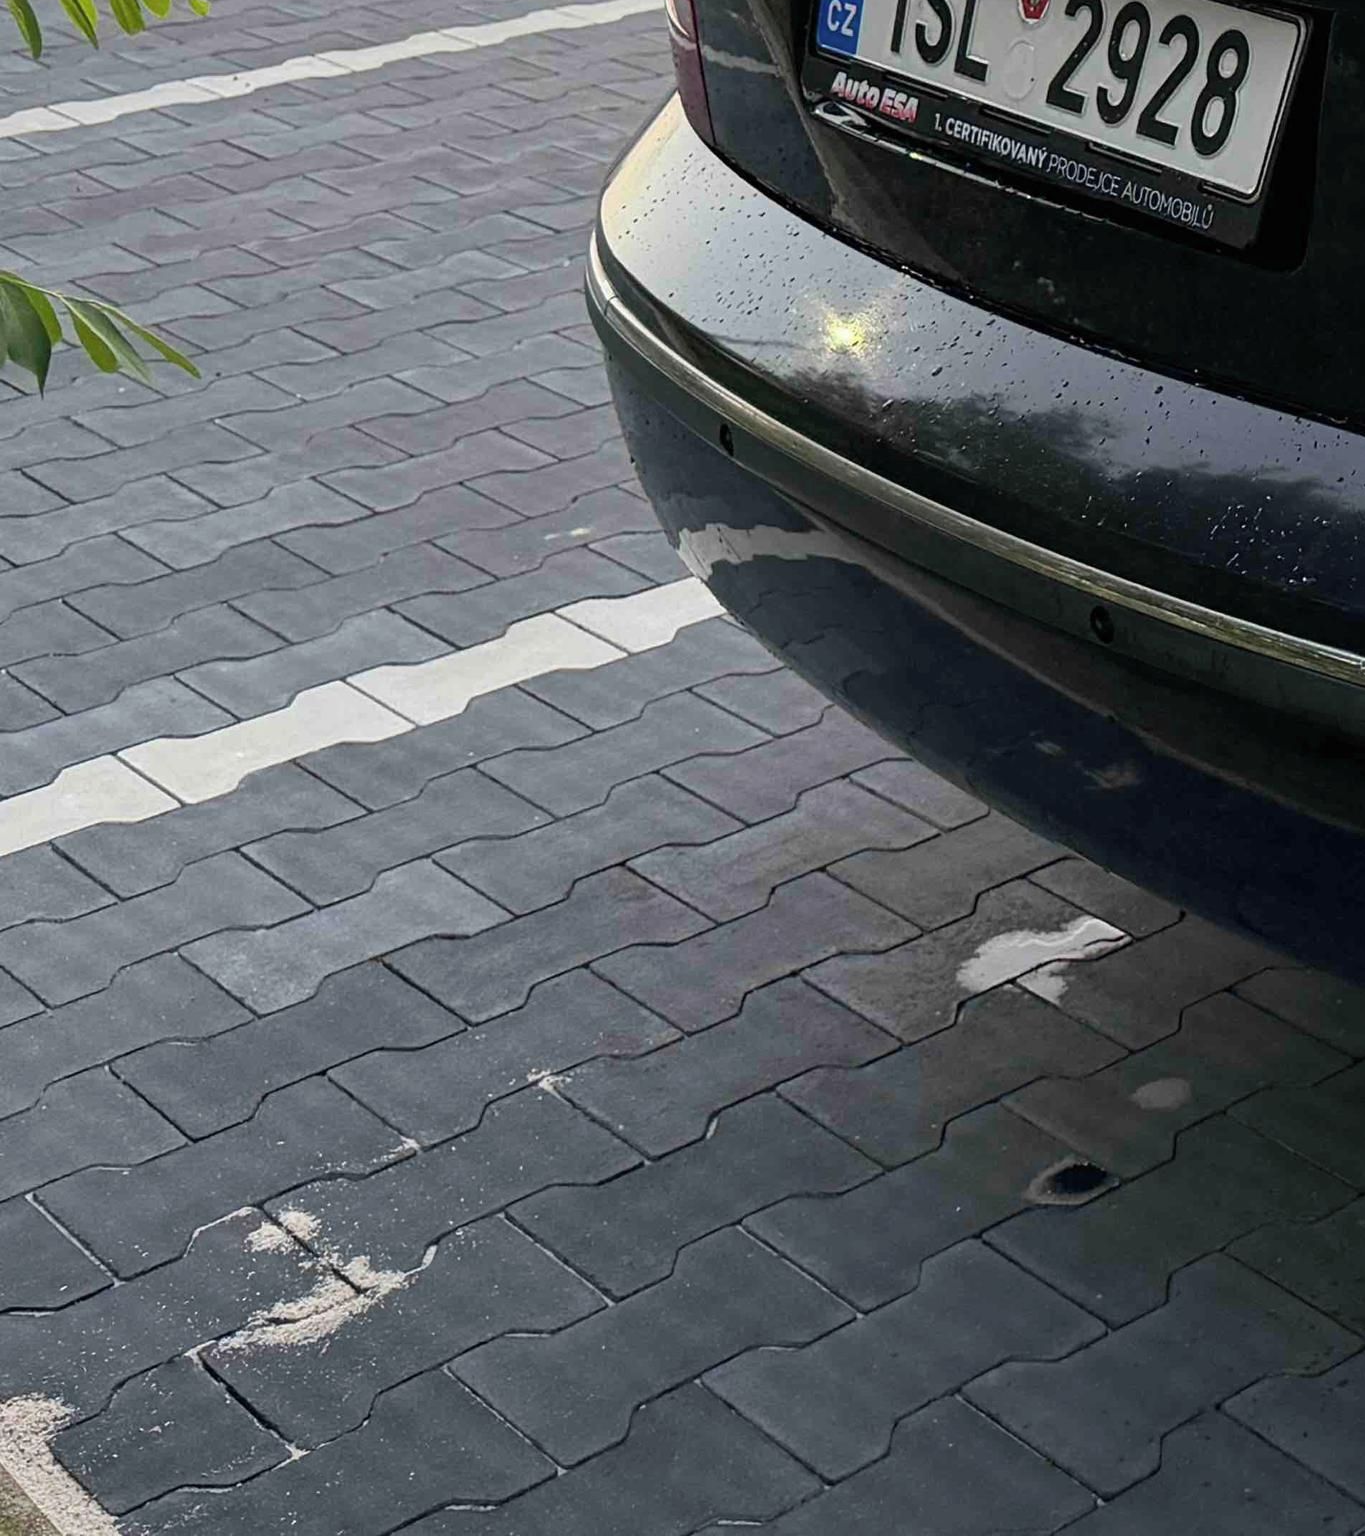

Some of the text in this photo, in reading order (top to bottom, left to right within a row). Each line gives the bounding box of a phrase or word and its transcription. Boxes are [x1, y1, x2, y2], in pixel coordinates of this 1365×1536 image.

[879, 87, 919, 124] ESA
[934, 113, 1215, 230] 1. CERTIFIKOVANÝ PRODEJCE AUTOMOBILŮ
